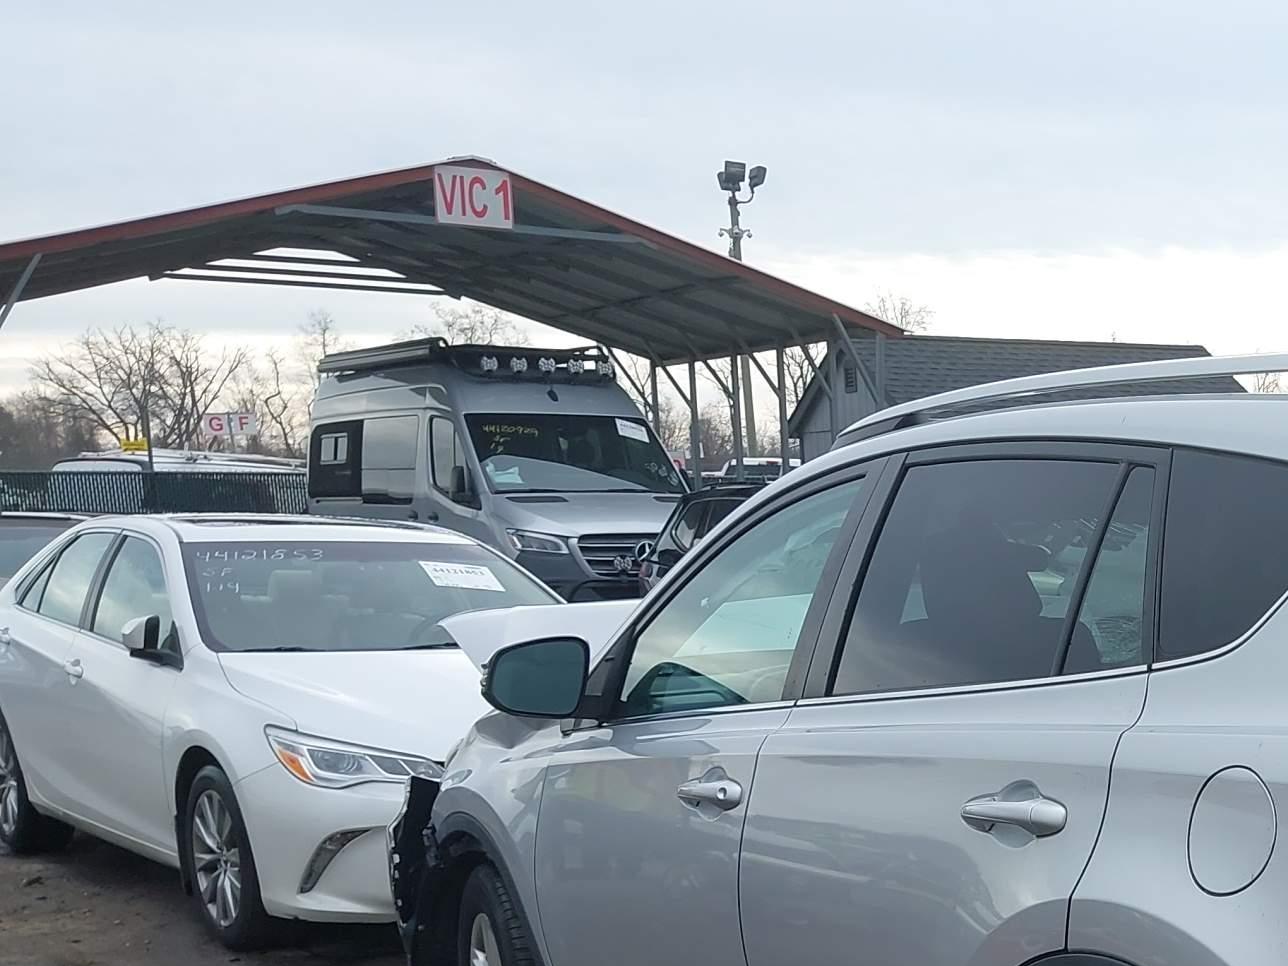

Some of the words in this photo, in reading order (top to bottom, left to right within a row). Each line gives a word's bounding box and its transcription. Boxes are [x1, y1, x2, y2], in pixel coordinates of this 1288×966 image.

[437, 172, 488, 218] VIC
[495, 179, 511, 221] 1
[208, 416, 224, 431] G
[239, 416, 249, 430] F
[197, 549, 324, 562] 44121853
